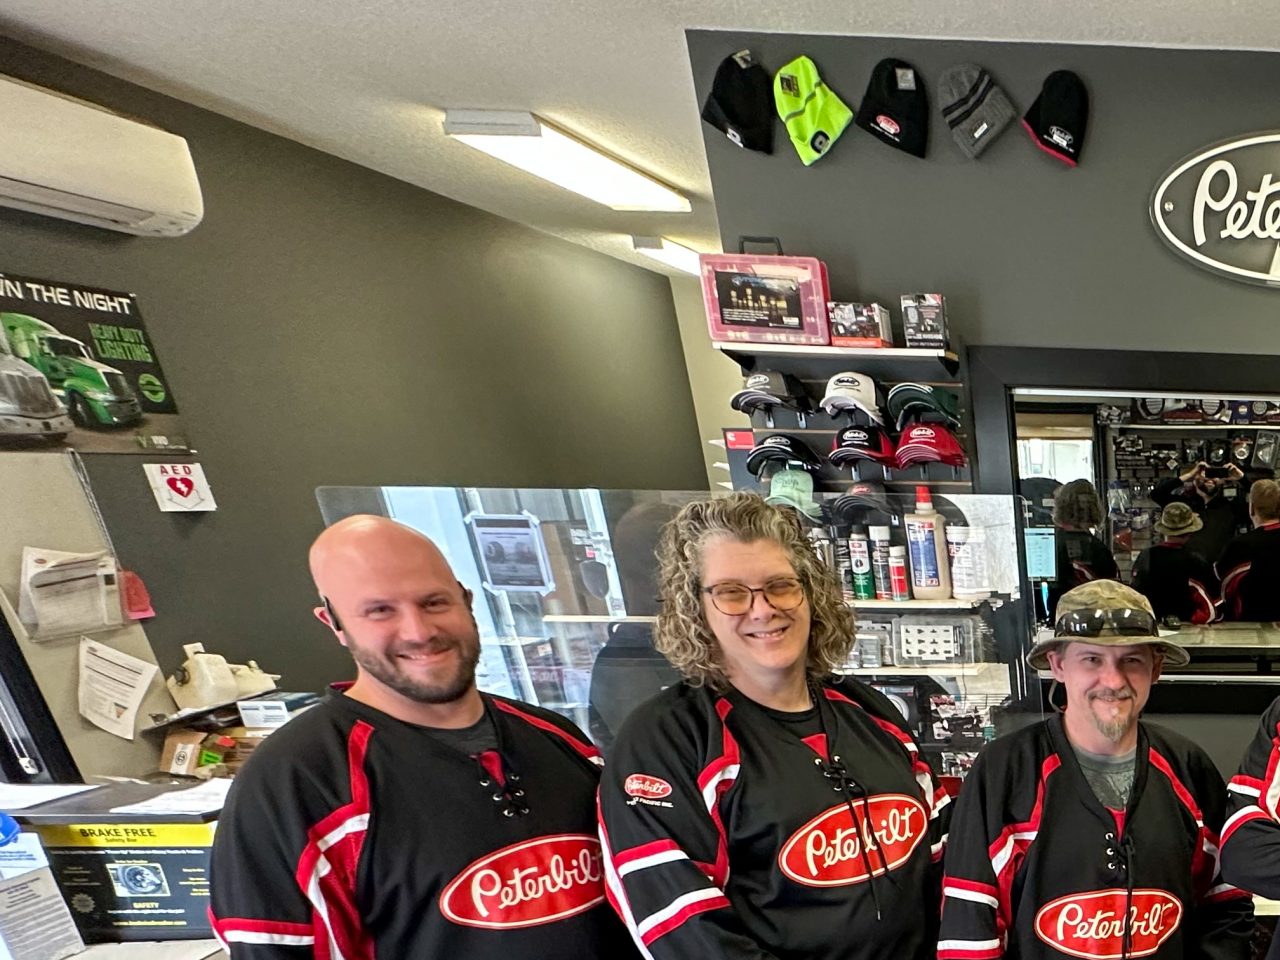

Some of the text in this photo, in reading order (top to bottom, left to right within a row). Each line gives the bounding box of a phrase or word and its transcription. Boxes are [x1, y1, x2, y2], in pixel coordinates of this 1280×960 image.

[0, 278, 132, 315] IN THE NIGHT
[88, 323, 145, 344] HEAVY DUTY
[95, 339, 153, 363] LIGHTING
[160, 465, 192, 475] AED
[79, 828, 157, 837] BRAKE FREE
